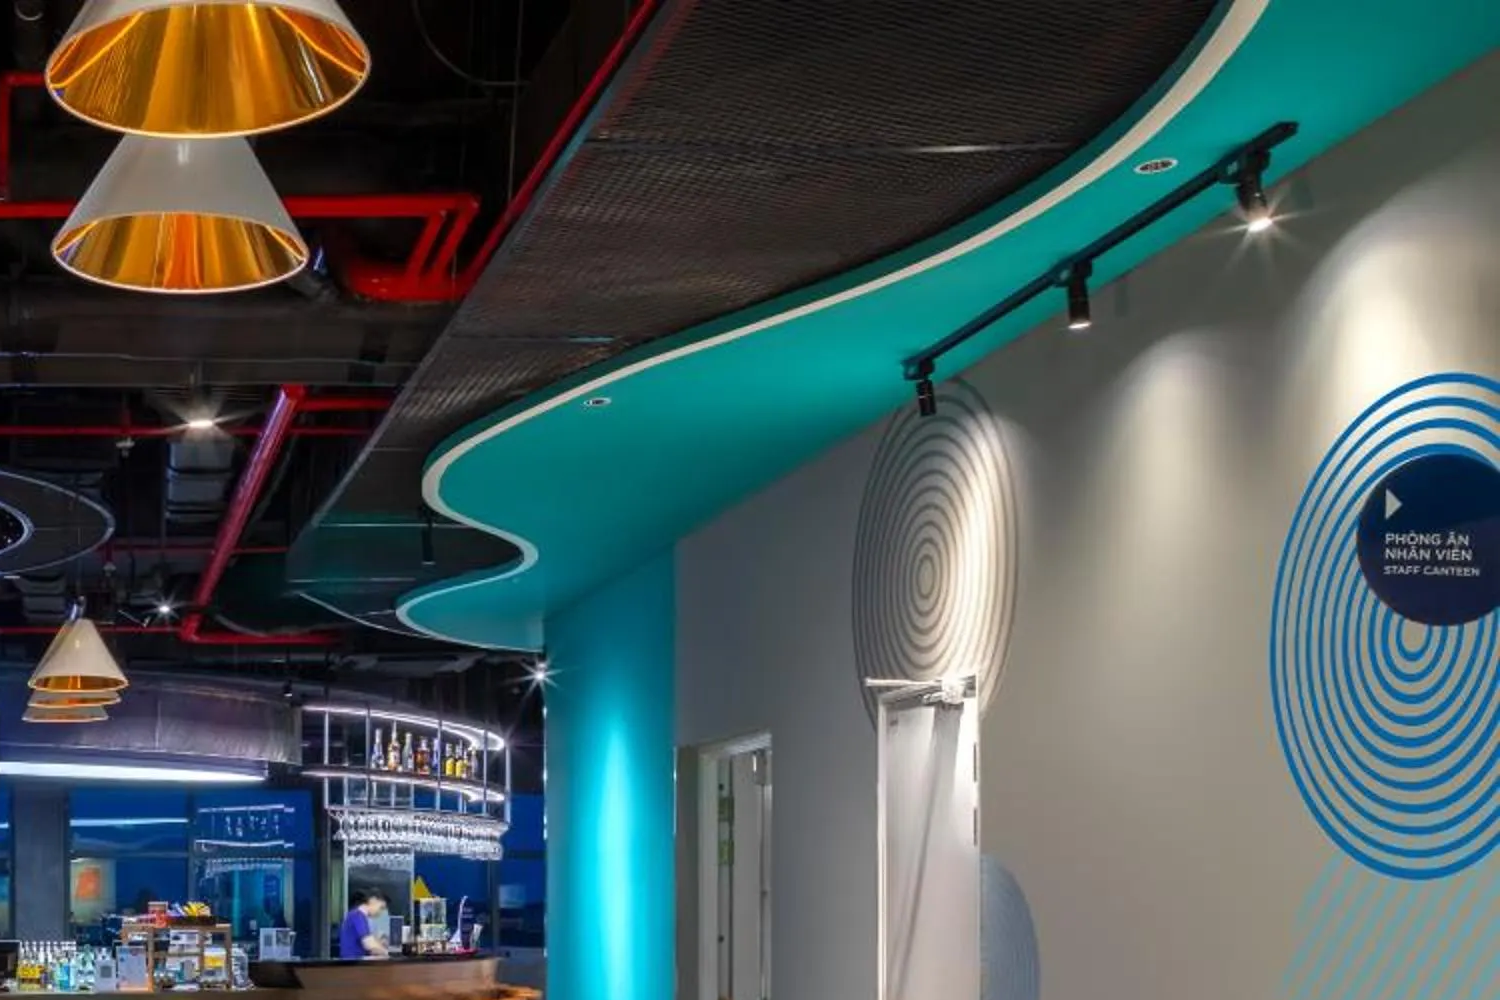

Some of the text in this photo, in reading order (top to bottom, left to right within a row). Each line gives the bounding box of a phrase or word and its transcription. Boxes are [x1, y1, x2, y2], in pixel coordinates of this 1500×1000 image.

[1385, 530, 1441, 545] PHÒNG
[1385, 546, 1473, 561] NHÂN VIÊN
[1384, 565, 1480, 577] STAFF CANTEEN
